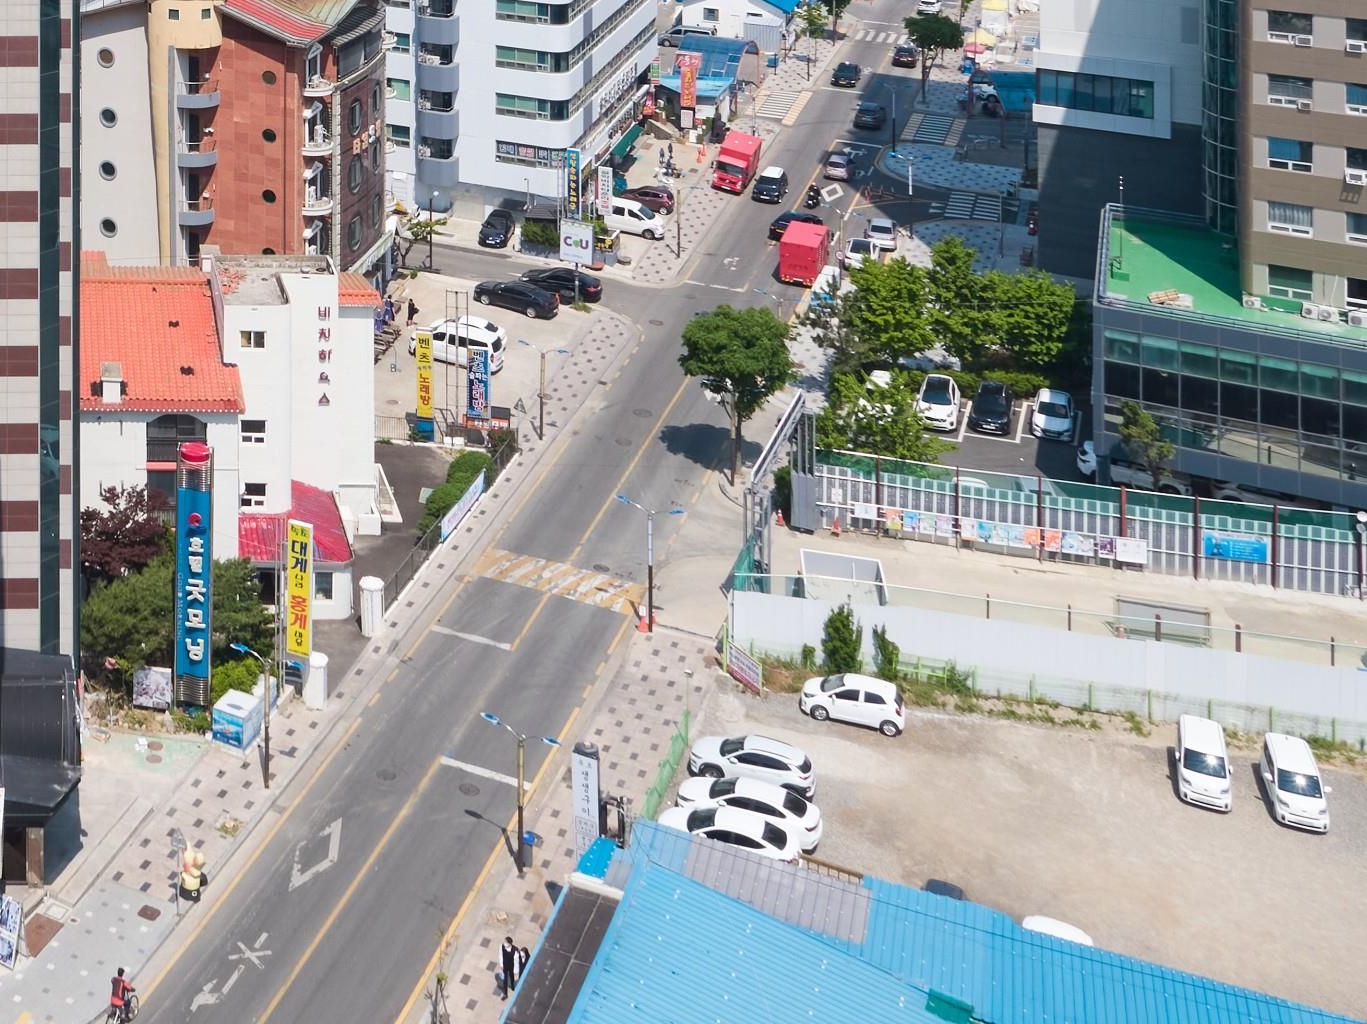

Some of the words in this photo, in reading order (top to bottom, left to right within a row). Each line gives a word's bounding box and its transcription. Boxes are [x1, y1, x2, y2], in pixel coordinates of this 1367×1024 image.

[318, 306, 331, 407] 비치하우스
[418, 337, 431, 363] 벤츠
[419, 373, 431, 406] 노래방
[291, 539, 308, 574] 대게
[185, 578, 207, 661] 굿모닝
[289, 595, 309, 631] 홍게
